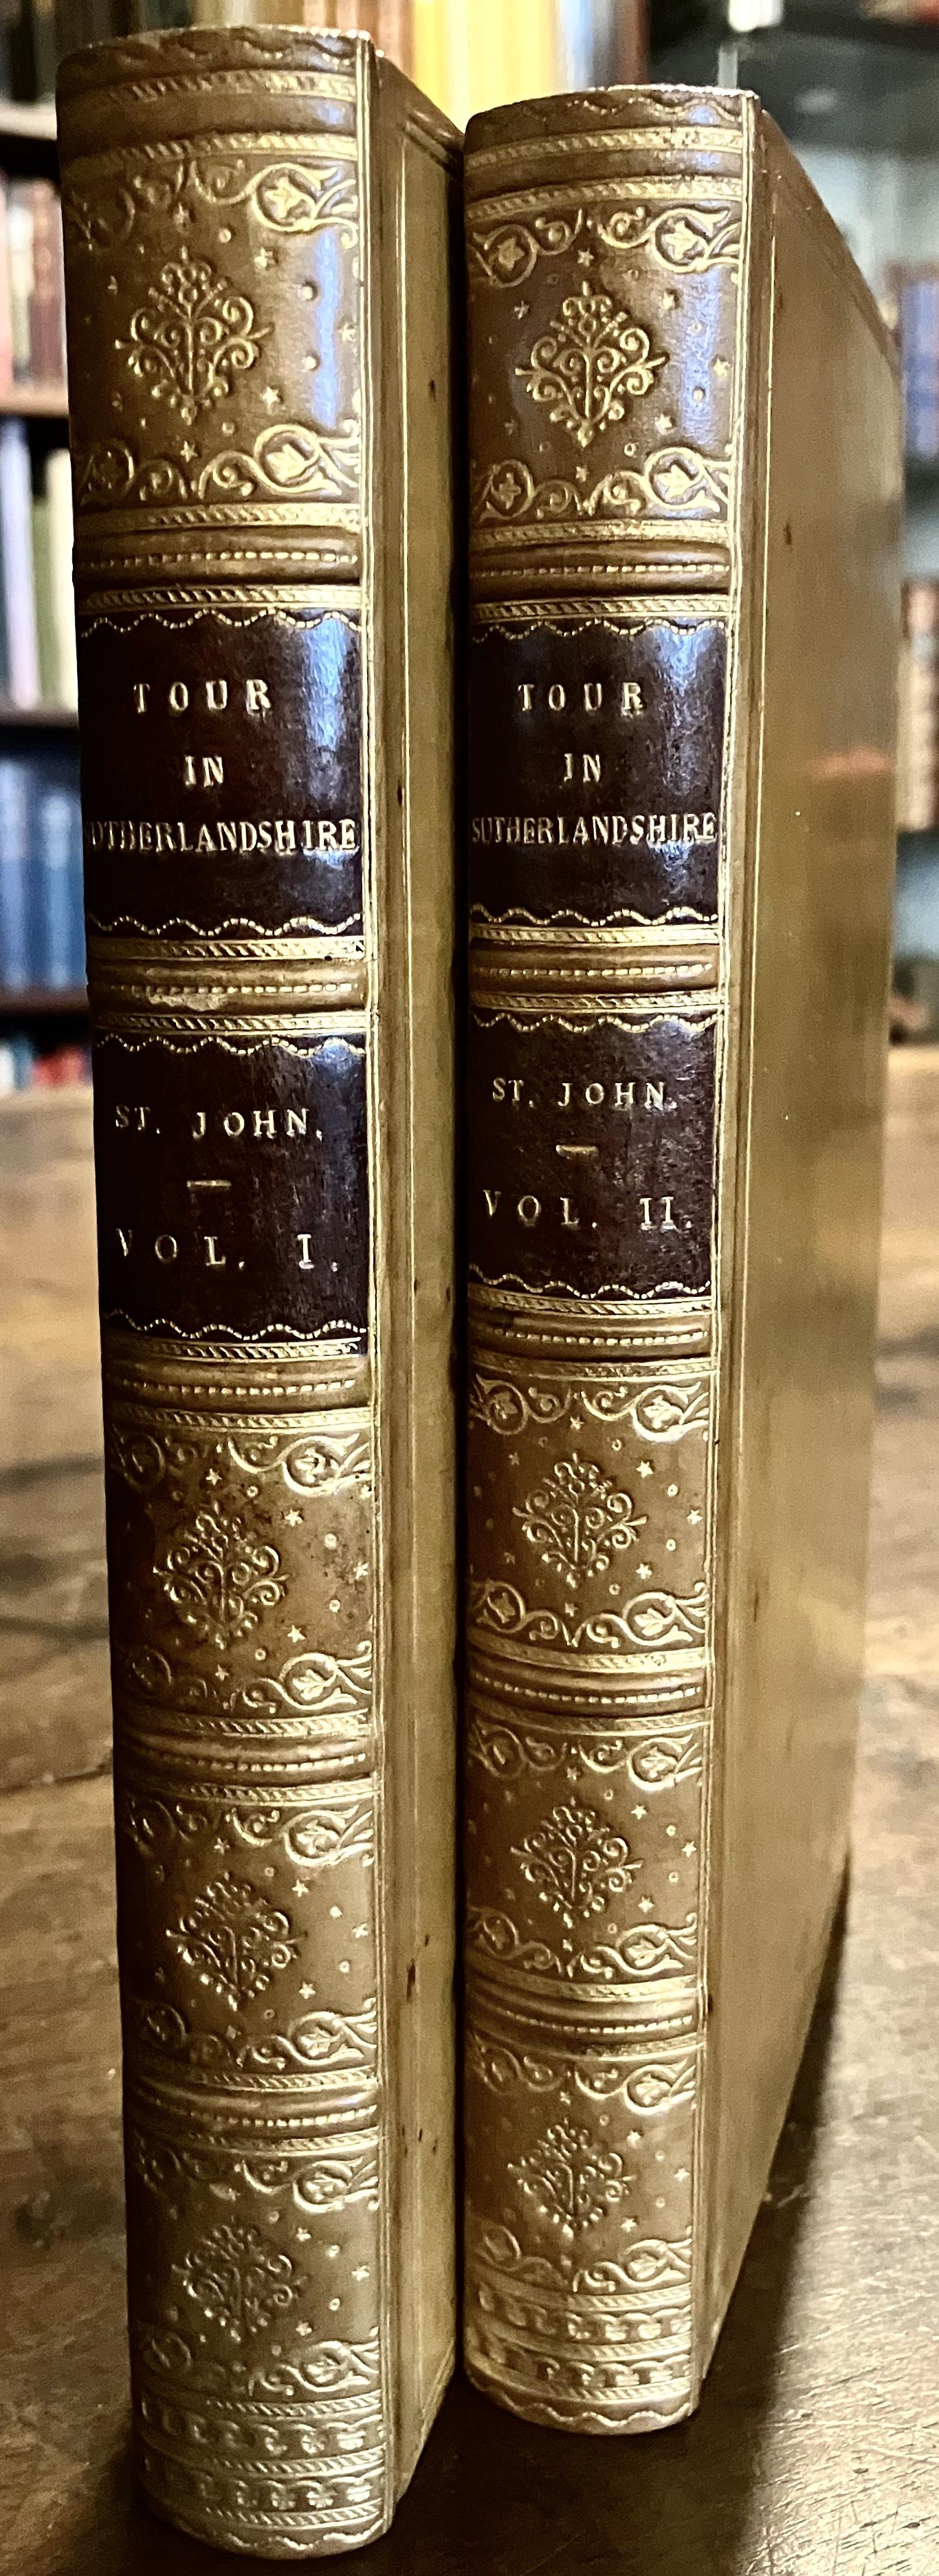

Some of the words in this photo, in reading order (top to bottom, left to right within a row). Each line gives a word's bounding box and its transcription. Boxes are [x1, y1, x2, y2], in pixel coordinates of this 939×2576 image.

[133, 679, 272, 715] TOUR
[518, 681, 645, 714] TOUR
[184, 755, 224, 787] IN
[563, 753, 602, 783] IN
[472, 812, 717, 847] SUTHERLANDSHIRE
[489, 1078, 534, 1109] ST.
[115, 1105, 160, 1134] ST.
[483, 1190, 597, 1227] VOL.
[639, 1196, 692, 1231] II.
[115, 1227, 245, 1269] VOL.
[297, 1234, 339, 1272] I.
